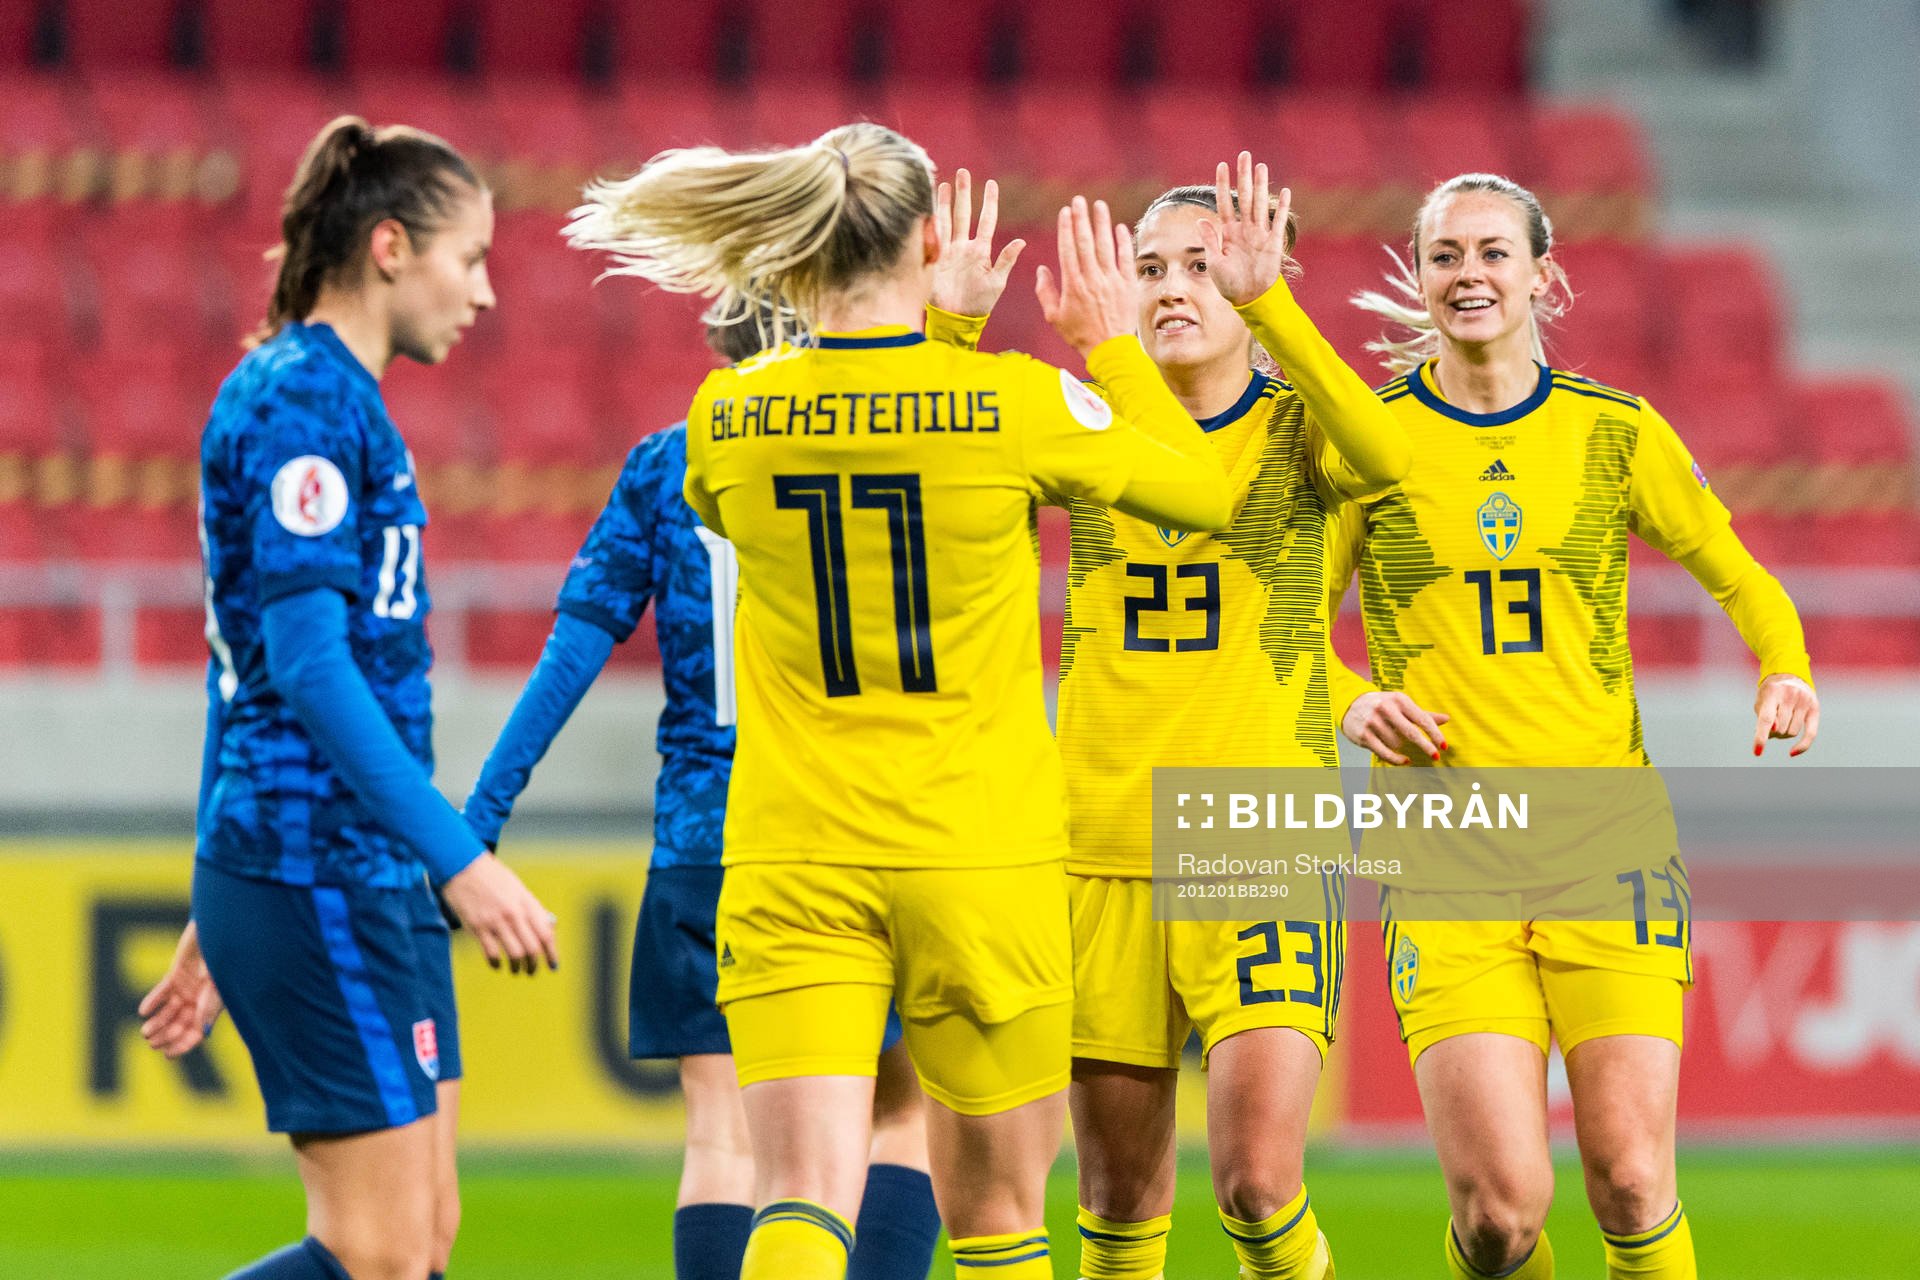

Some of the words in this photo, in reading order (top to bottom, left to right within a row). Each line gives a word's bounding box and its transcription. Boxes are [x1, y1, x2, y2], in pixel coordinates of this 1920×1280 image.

[711, 391, 1000, 441] BLACKSTENIUS
[1479, 472, 1515, 481] adidas
[772, 473, 938, 697] 11
[1124, 562, 1220, 652] 23
[1464, 568, 1543, 655] 13
[1616, 868, 1684, 949] 13
[1236, 921, 1324, 1008] 23
